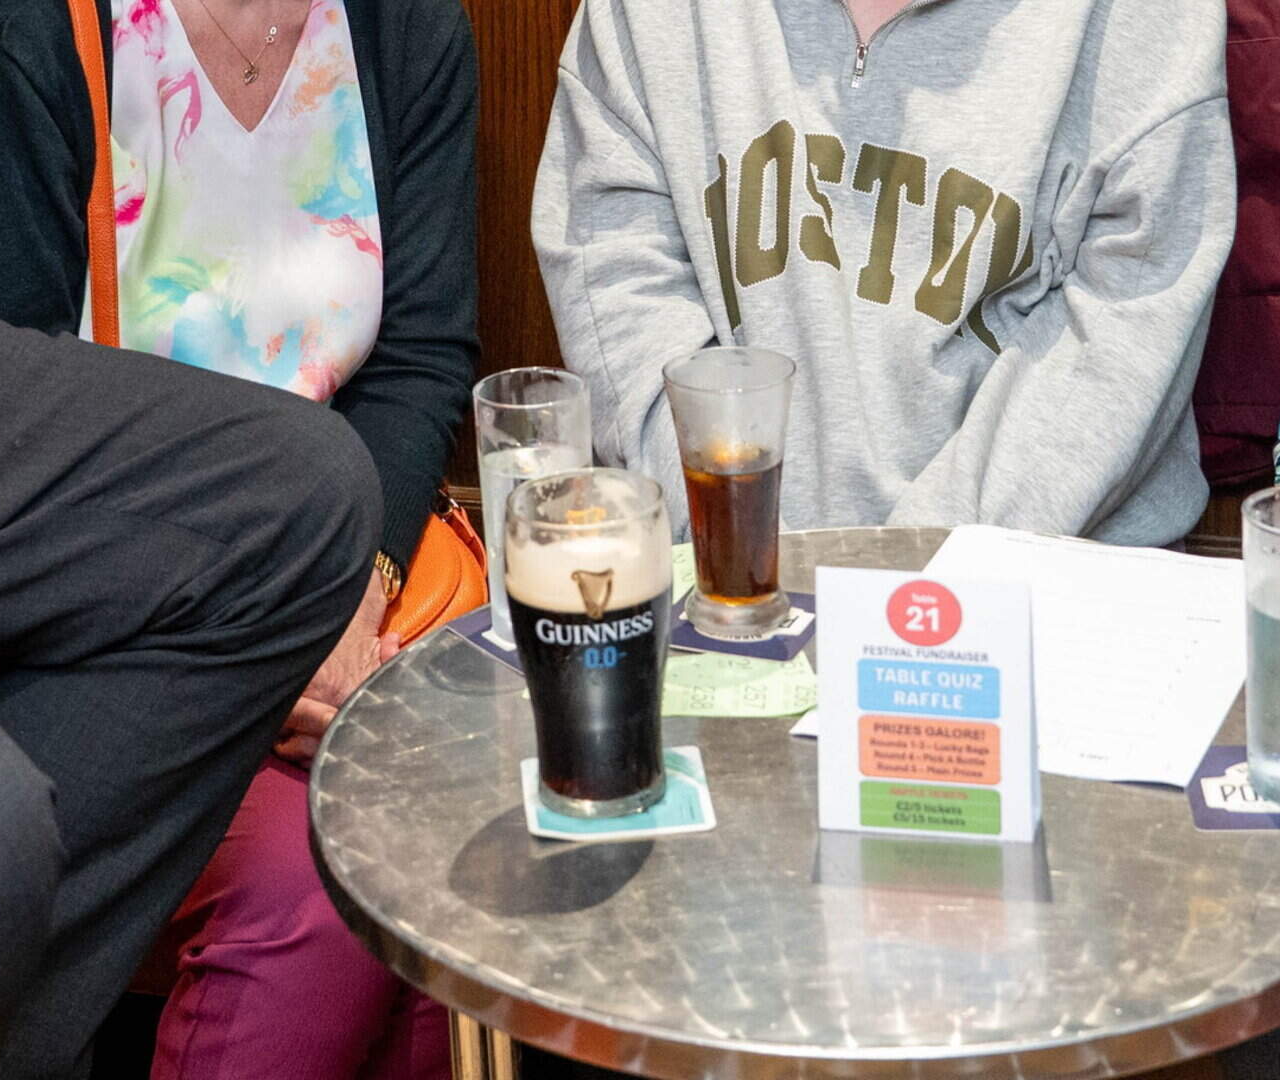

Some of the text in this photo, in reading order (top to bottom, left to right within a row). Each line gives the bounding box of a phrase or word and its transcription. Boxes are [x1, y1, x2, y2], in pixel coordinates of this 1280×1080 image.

[703, 119, 1033, 356] OSTO
[535, 610, 655, 646] GUINNESS
[905, 605, 940, 632] 21
[862, 645, 989, 663] FESTIVAL FUNDRAISER
[874, 667, 984, 690] TABLE QUIZ
[893, 690, 963, 710] RAFFLE
[873, 722, 922, 736] PRIZES
